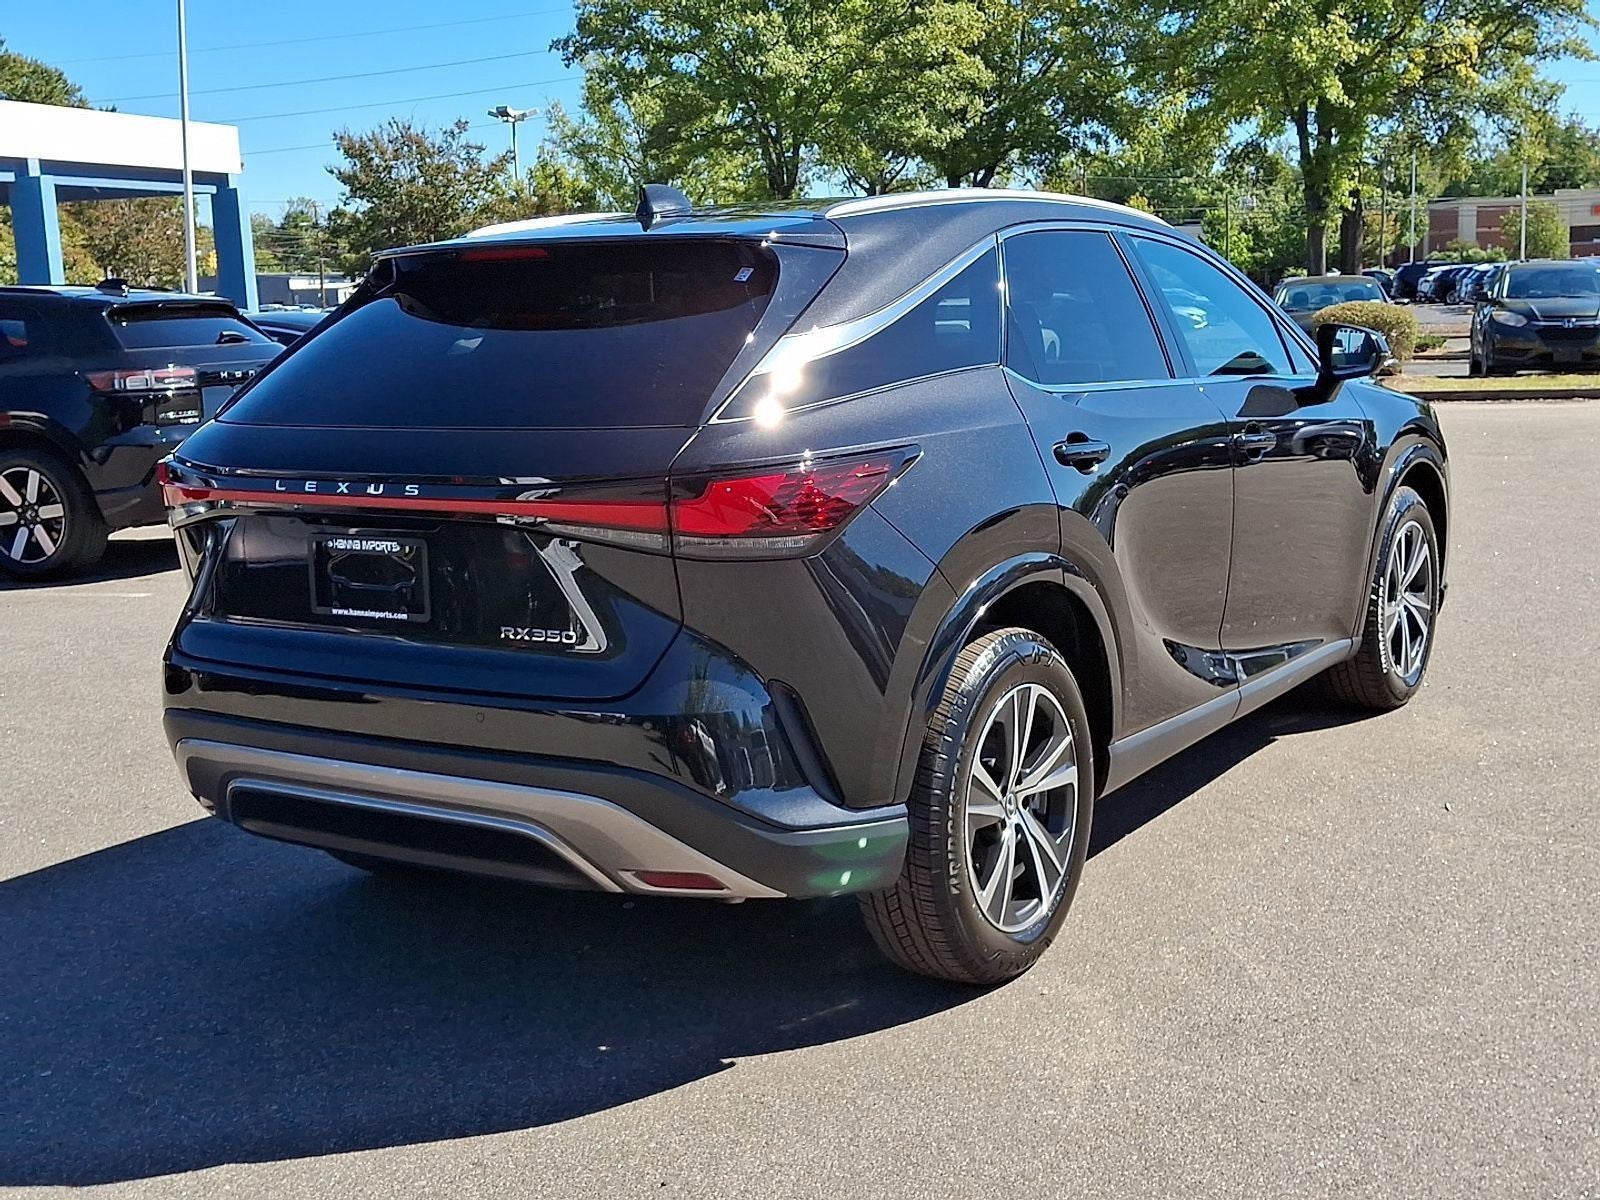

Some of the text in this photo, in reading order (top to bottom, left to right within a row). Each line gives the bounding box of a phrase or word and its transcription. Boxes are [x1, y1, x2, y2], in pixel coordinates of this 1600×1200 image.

[220, 370, 256, 379] HON
[275, 479, 420, 496] LEXUS
[361, 540, 400, 554] IMPORTS
[331, 607, 408, 620] www.hannaimports.com
